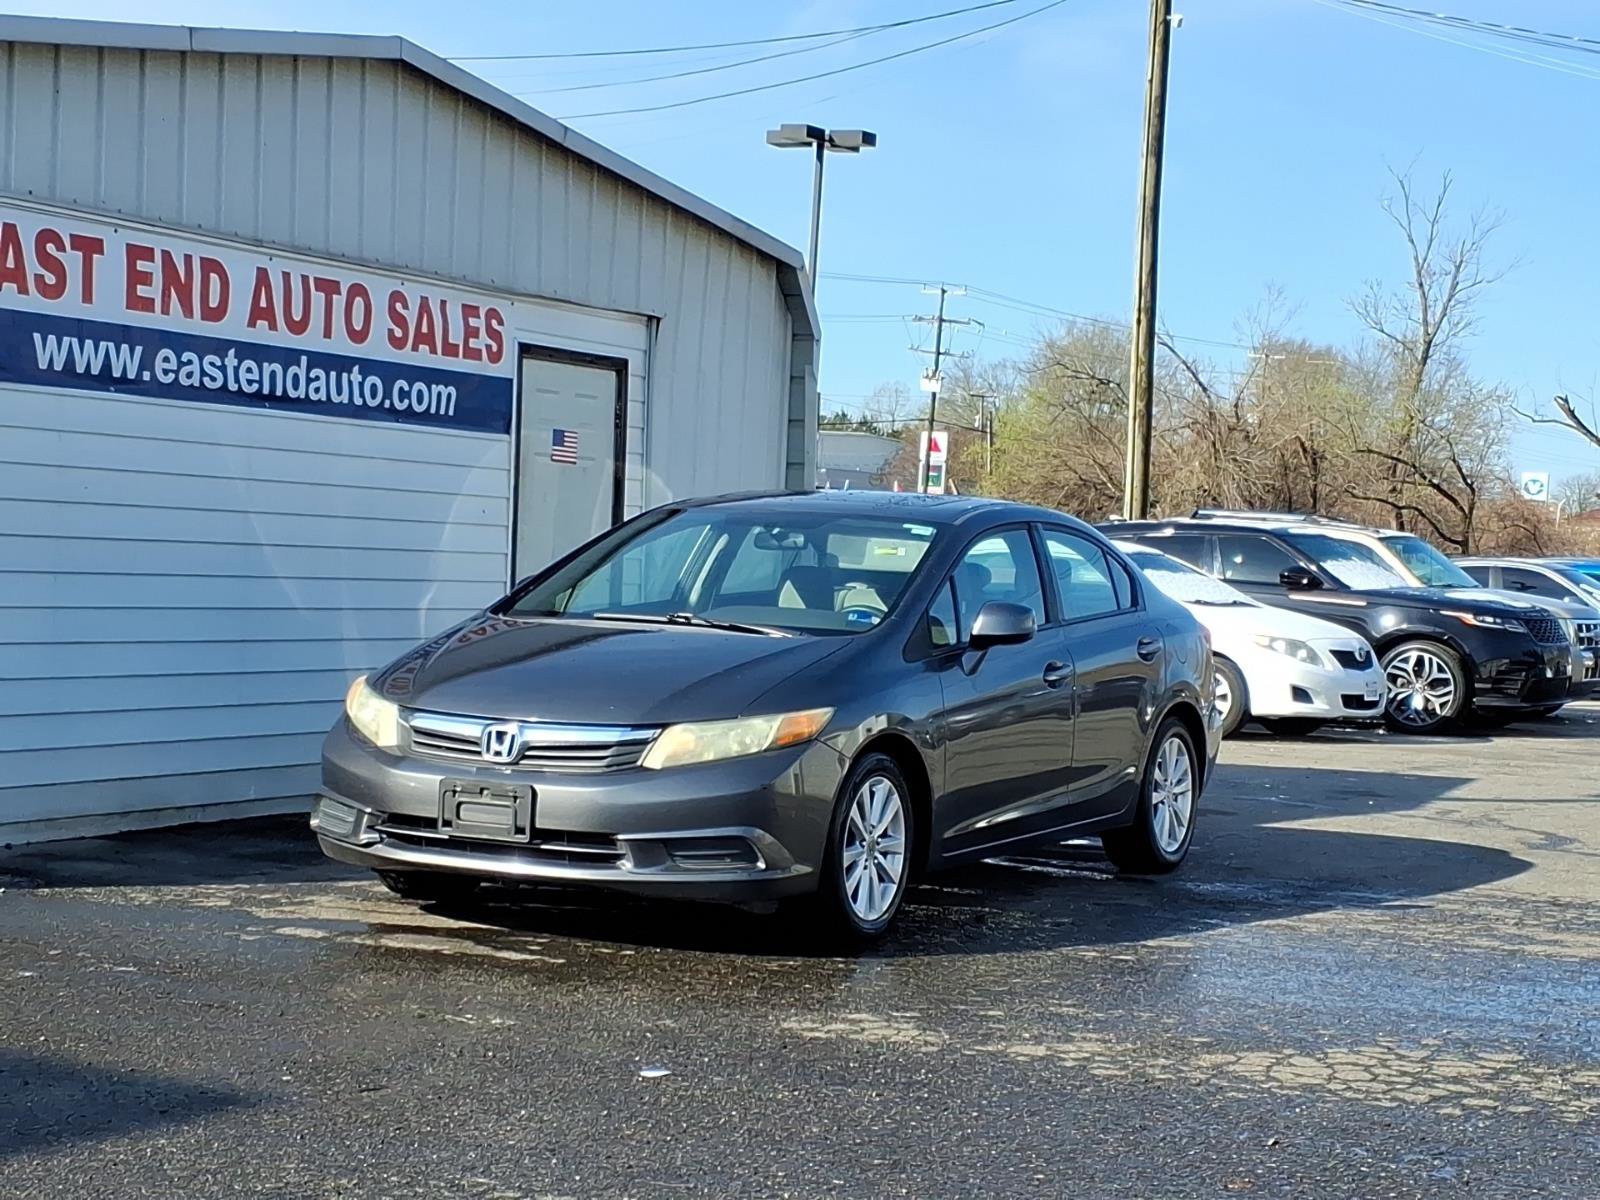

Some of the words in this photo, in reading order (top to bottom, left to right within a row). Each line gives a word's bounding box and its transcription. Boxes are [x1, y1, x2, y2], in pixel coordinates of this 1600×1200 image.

[0, 222, 105, 305] AST
[125, 242, 230, 323] END
[246, 266, 373, 345] AUTO
[386, 289, 505, 365] SALES
[33, 332, 457, 416] www.eastendauto.com
